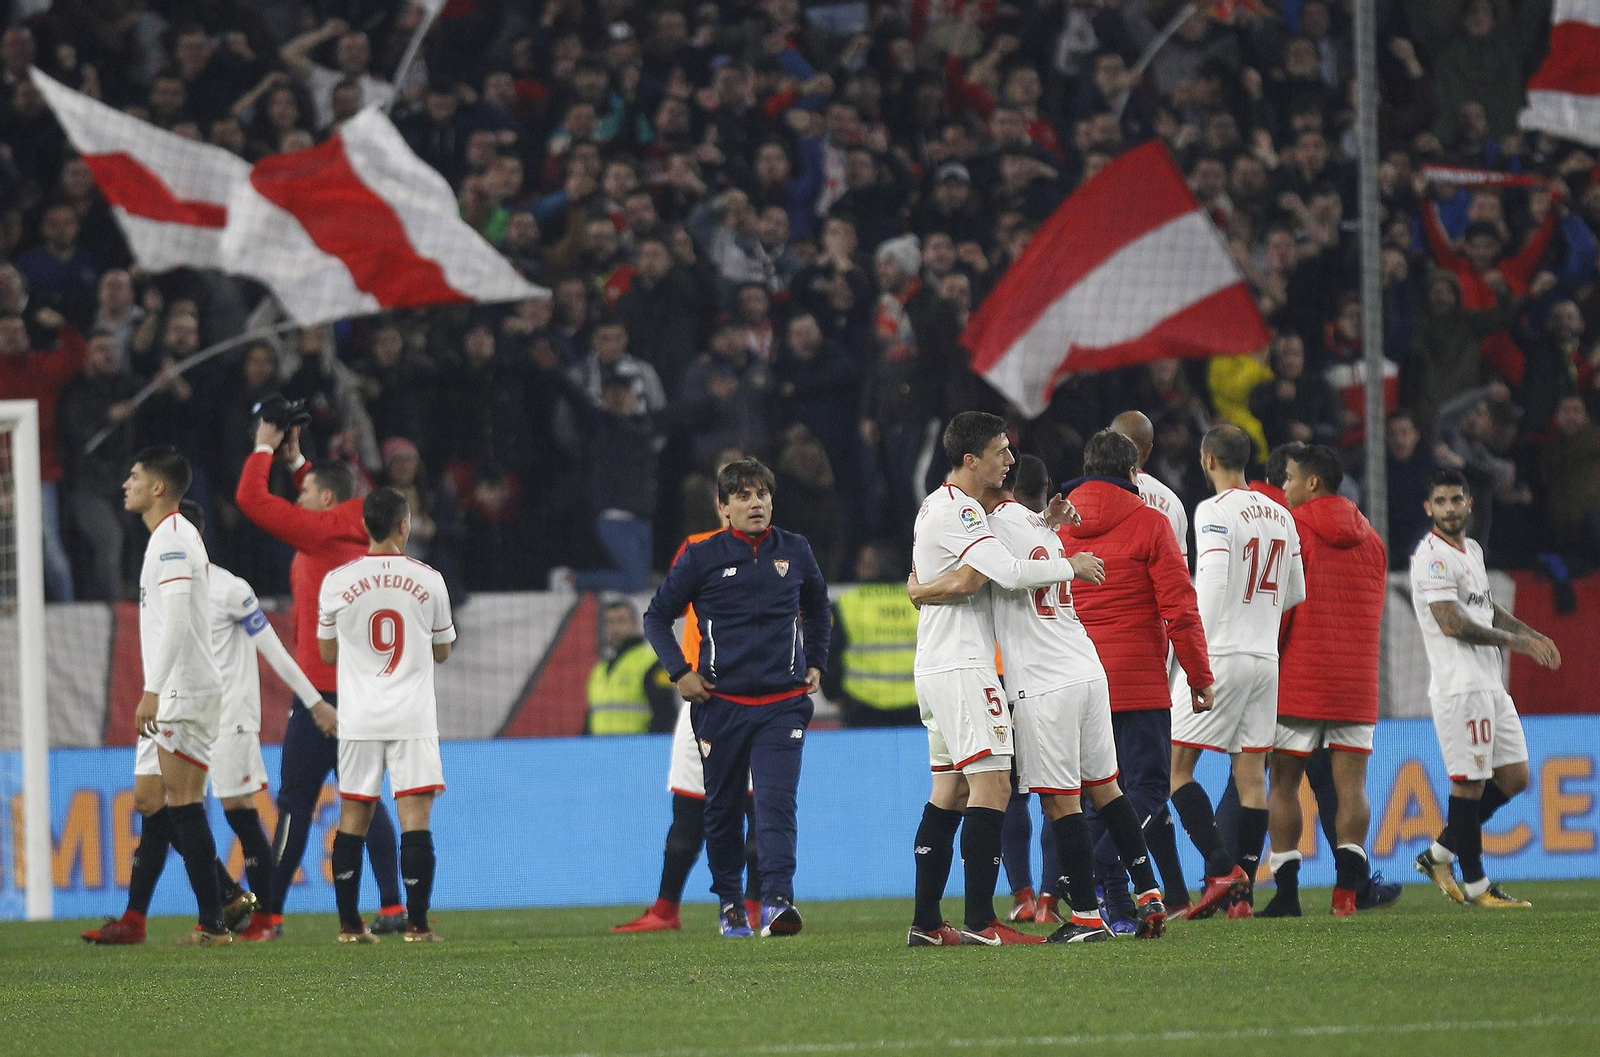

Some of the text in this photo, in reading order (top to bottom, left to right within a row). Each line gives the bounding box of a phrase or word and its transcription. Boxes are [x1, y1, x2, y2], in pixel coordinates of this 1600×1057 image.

[1241, 505, 1286, 527] PIZARRO
[1243, 537, 1286, 606] 14
[342, 574, 430, 604] BEN YEDDER
[368, 608, 405, 677] 9
[983, 687, 1003, 717] 5
[1466, 718, 1492, 746] 10
